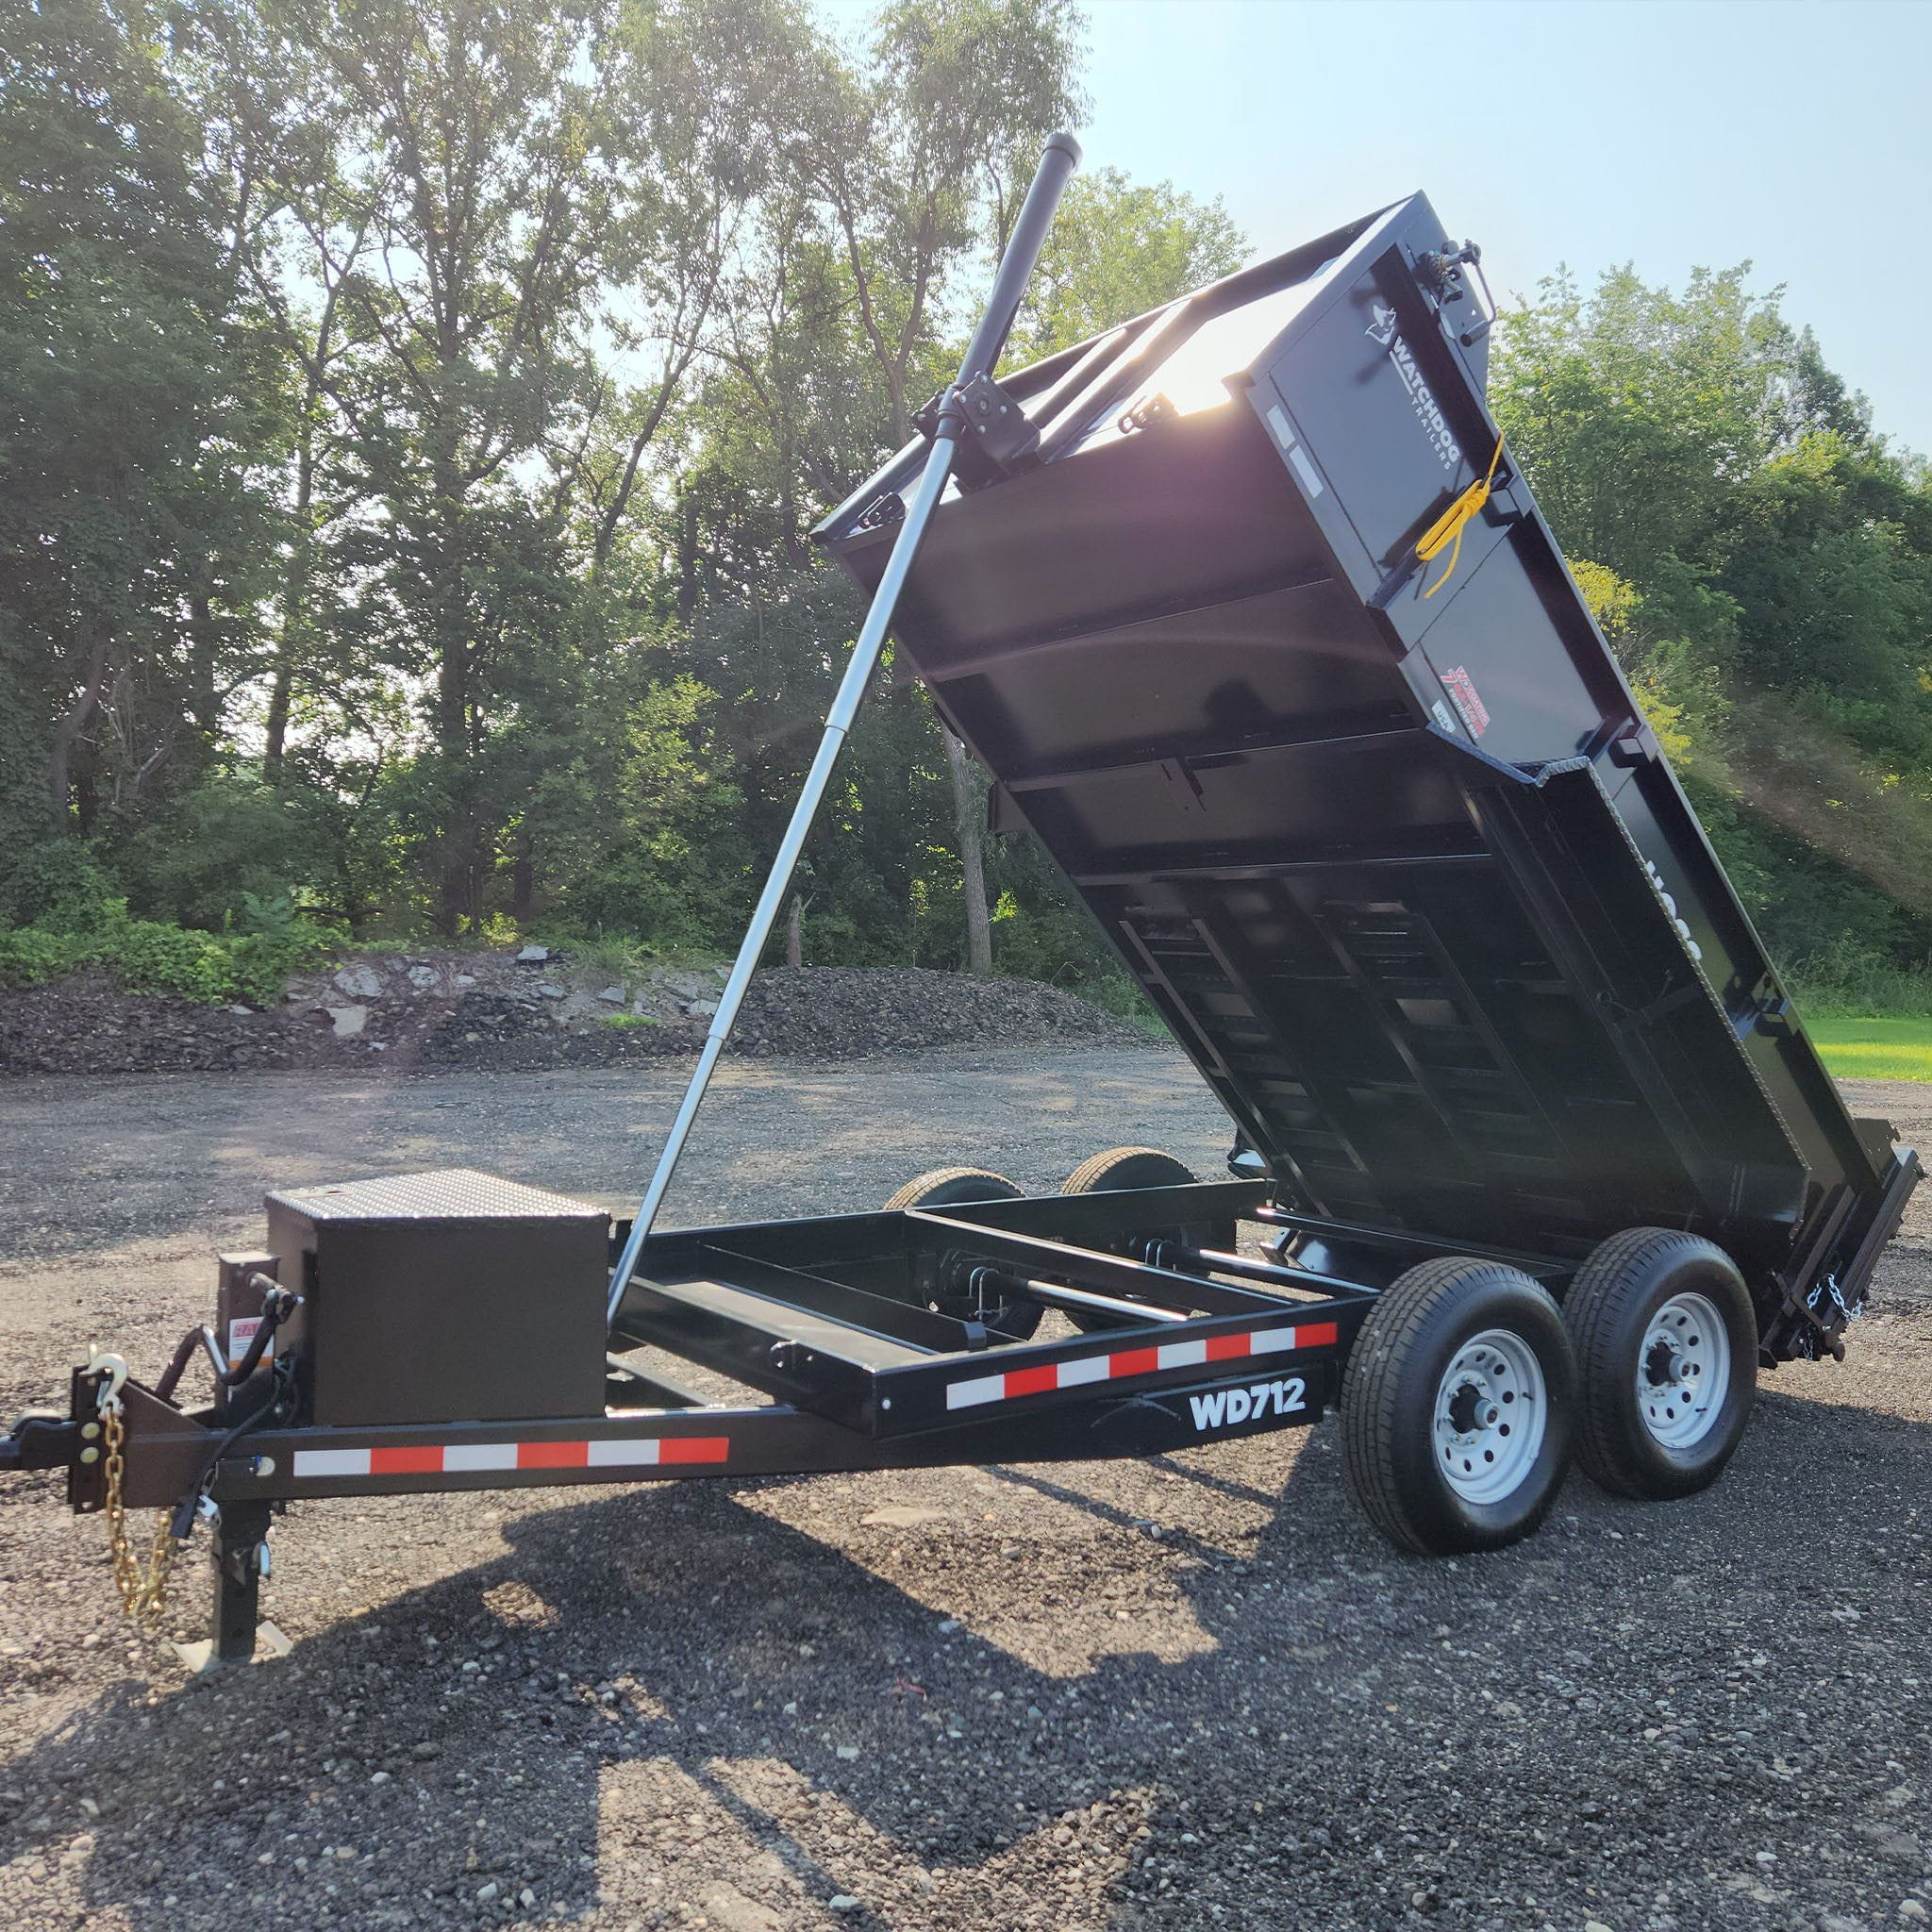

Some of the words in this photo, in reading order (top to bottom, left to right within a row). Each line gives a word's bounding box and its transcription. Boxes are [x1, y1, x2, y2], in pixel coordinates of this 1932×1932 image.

[1393, 335, 1460, 462] WATCHDOG
[1411, 396, 1451, 470] TRAILERS
[1440, 668, 1458, 683] 7
[1438, 710, 1449, 729] USA
[1189, 1377, 1307, 1431] WD712
